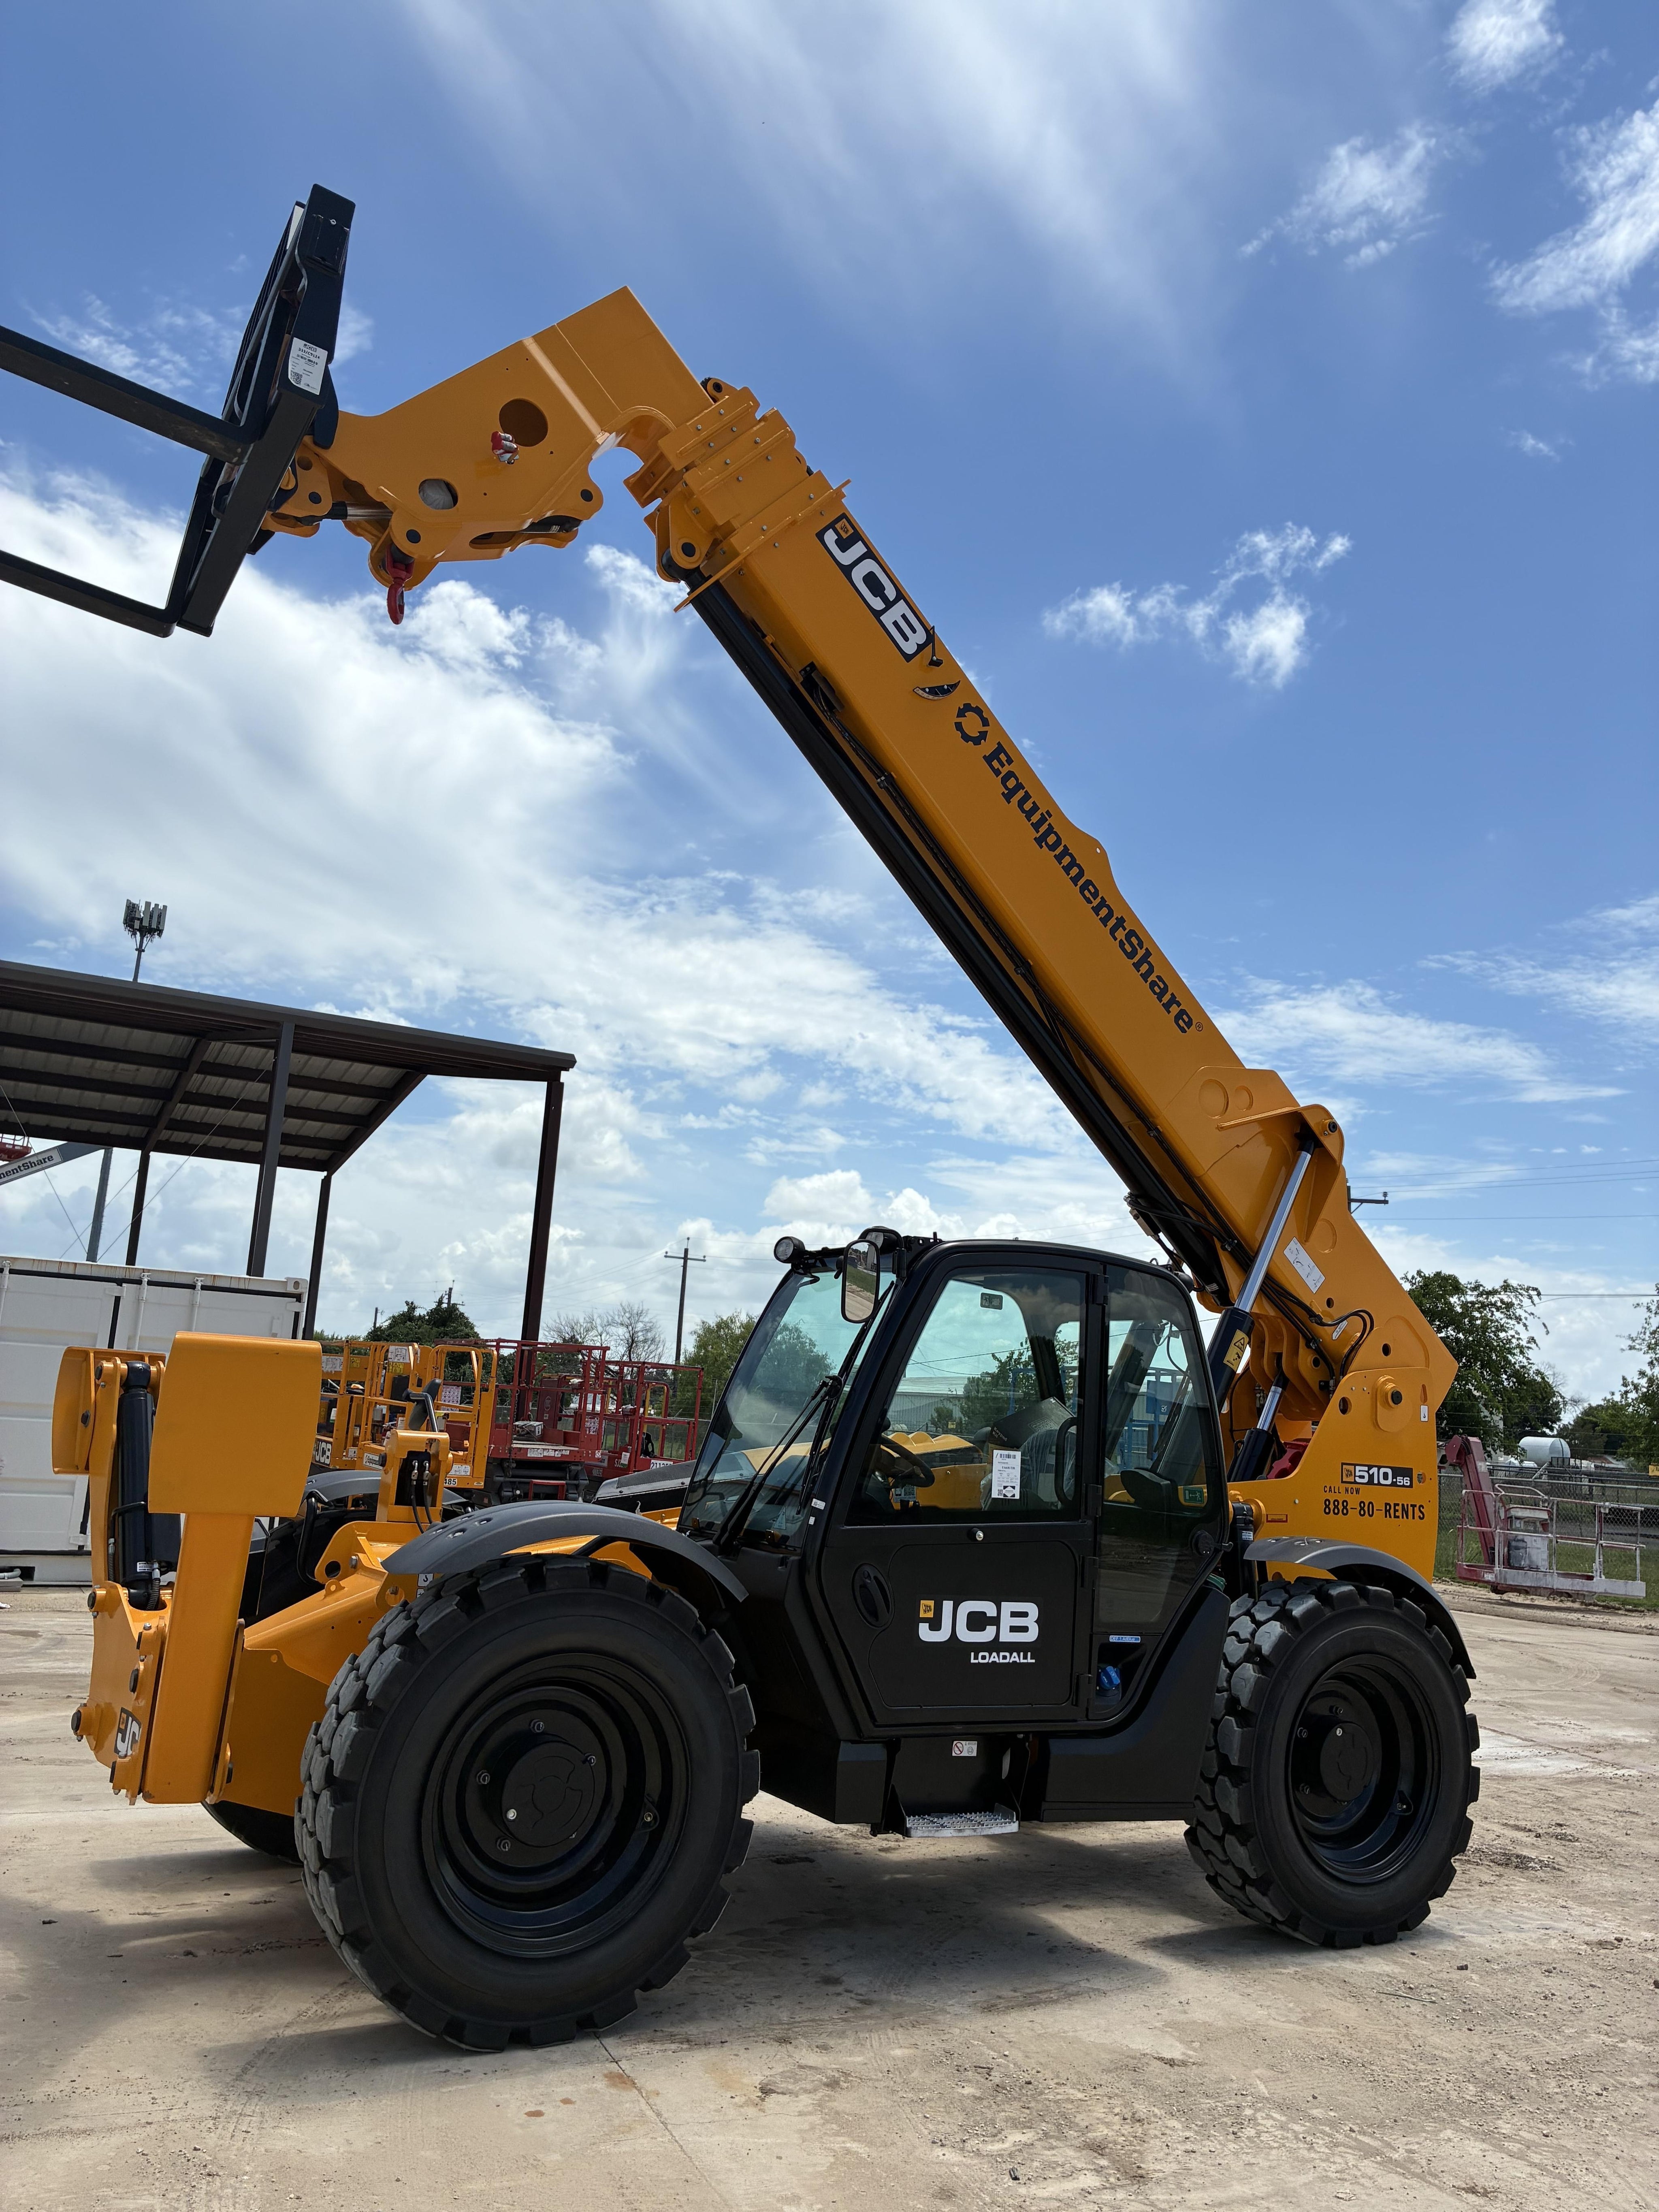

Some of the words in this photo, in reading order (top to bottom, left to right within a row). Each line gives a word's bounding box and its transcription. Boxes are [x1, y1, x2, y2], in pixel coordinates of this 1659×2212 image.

[823, 528, 927, 655] JCB
[983, 742, 1193, 1034] EquipmentShare
[315, 1441, 332, 1464] JCB
[1323, 1485, 1341, 1494] CALL
[1345, 1486, 1360, 1495] NOW
[1323, 1498, 1425, 1521] 888-80-RENTS
[919, 1600, 1039, 1642] JCB
[970, 1652, 1035, 1663] LOADALL
